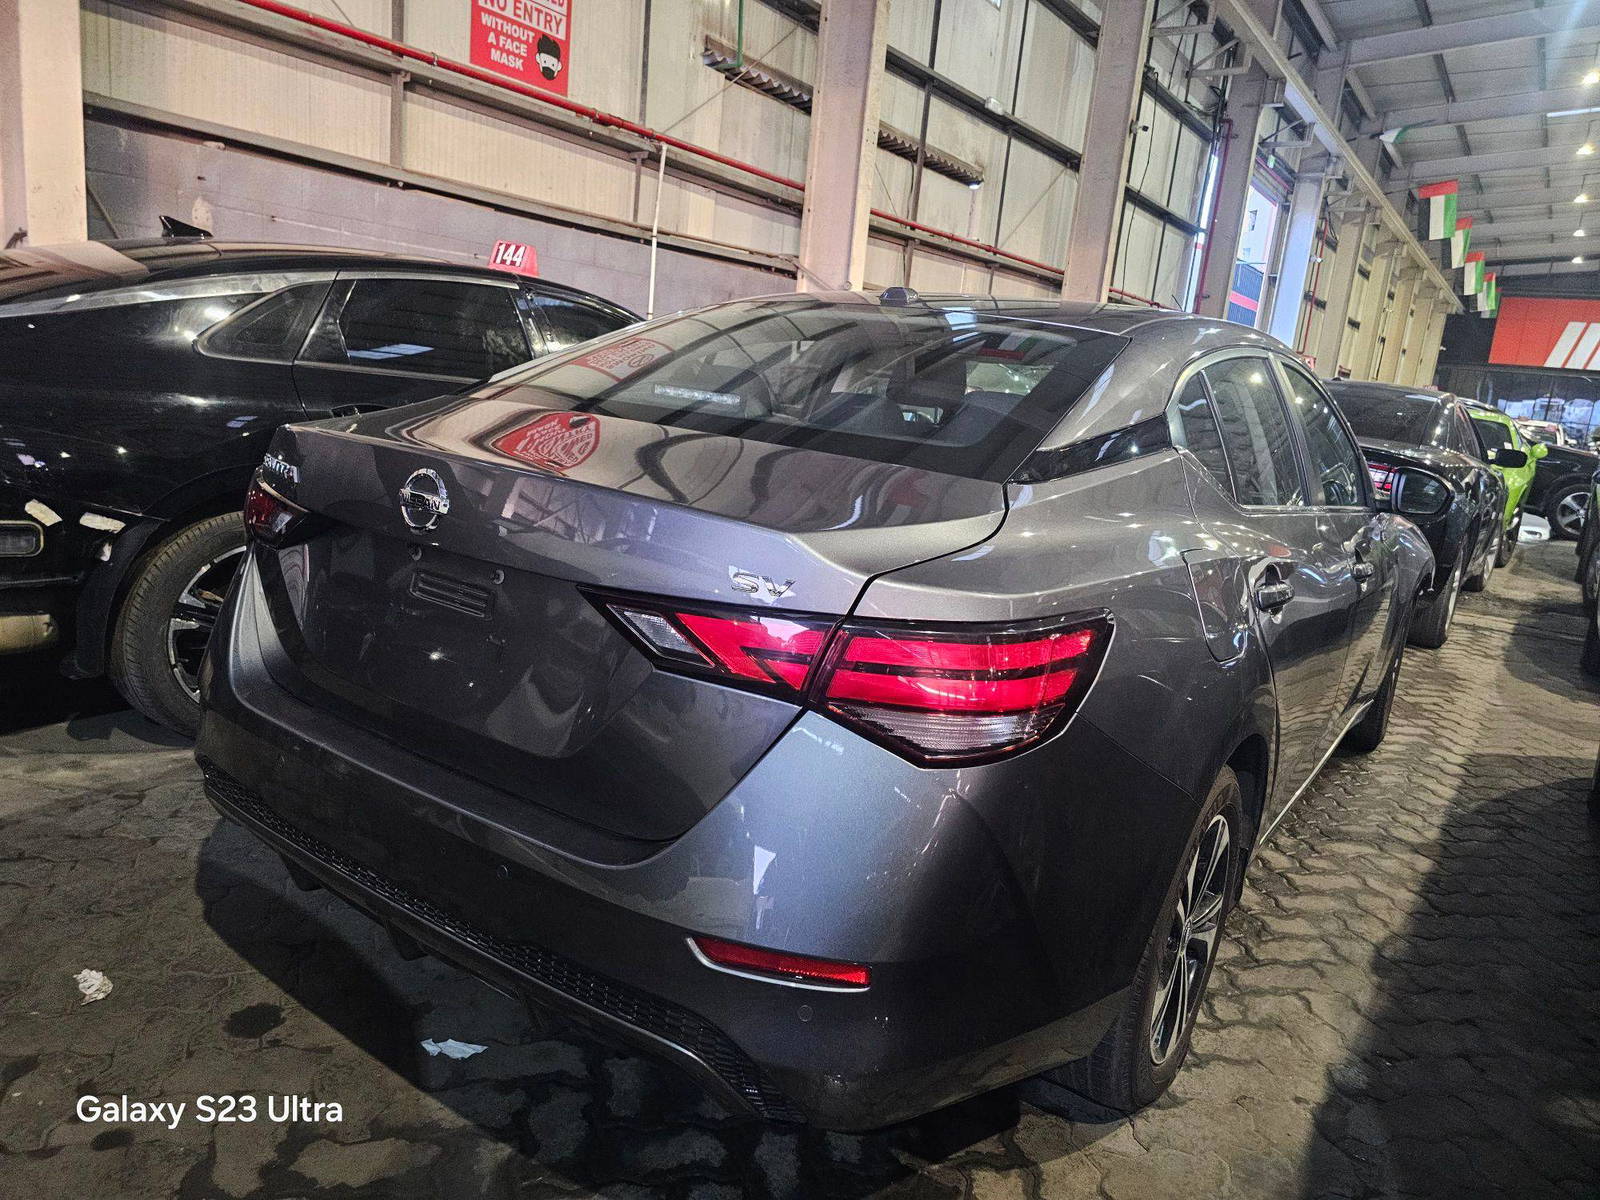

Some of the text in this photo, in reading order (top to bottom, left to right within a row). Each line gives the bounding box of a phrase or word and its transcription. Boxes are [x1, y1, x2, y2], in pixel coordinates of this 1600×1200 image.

[481, 12, 534, 43] WITHOUT
[514, 0, 562, 34] ENTRY
[488, 32, 527, 57] A FACE
[491, 47, 524, 71] MASK
[496, 243, 526, 267] 144
[731, 571, 796, 597] SV
